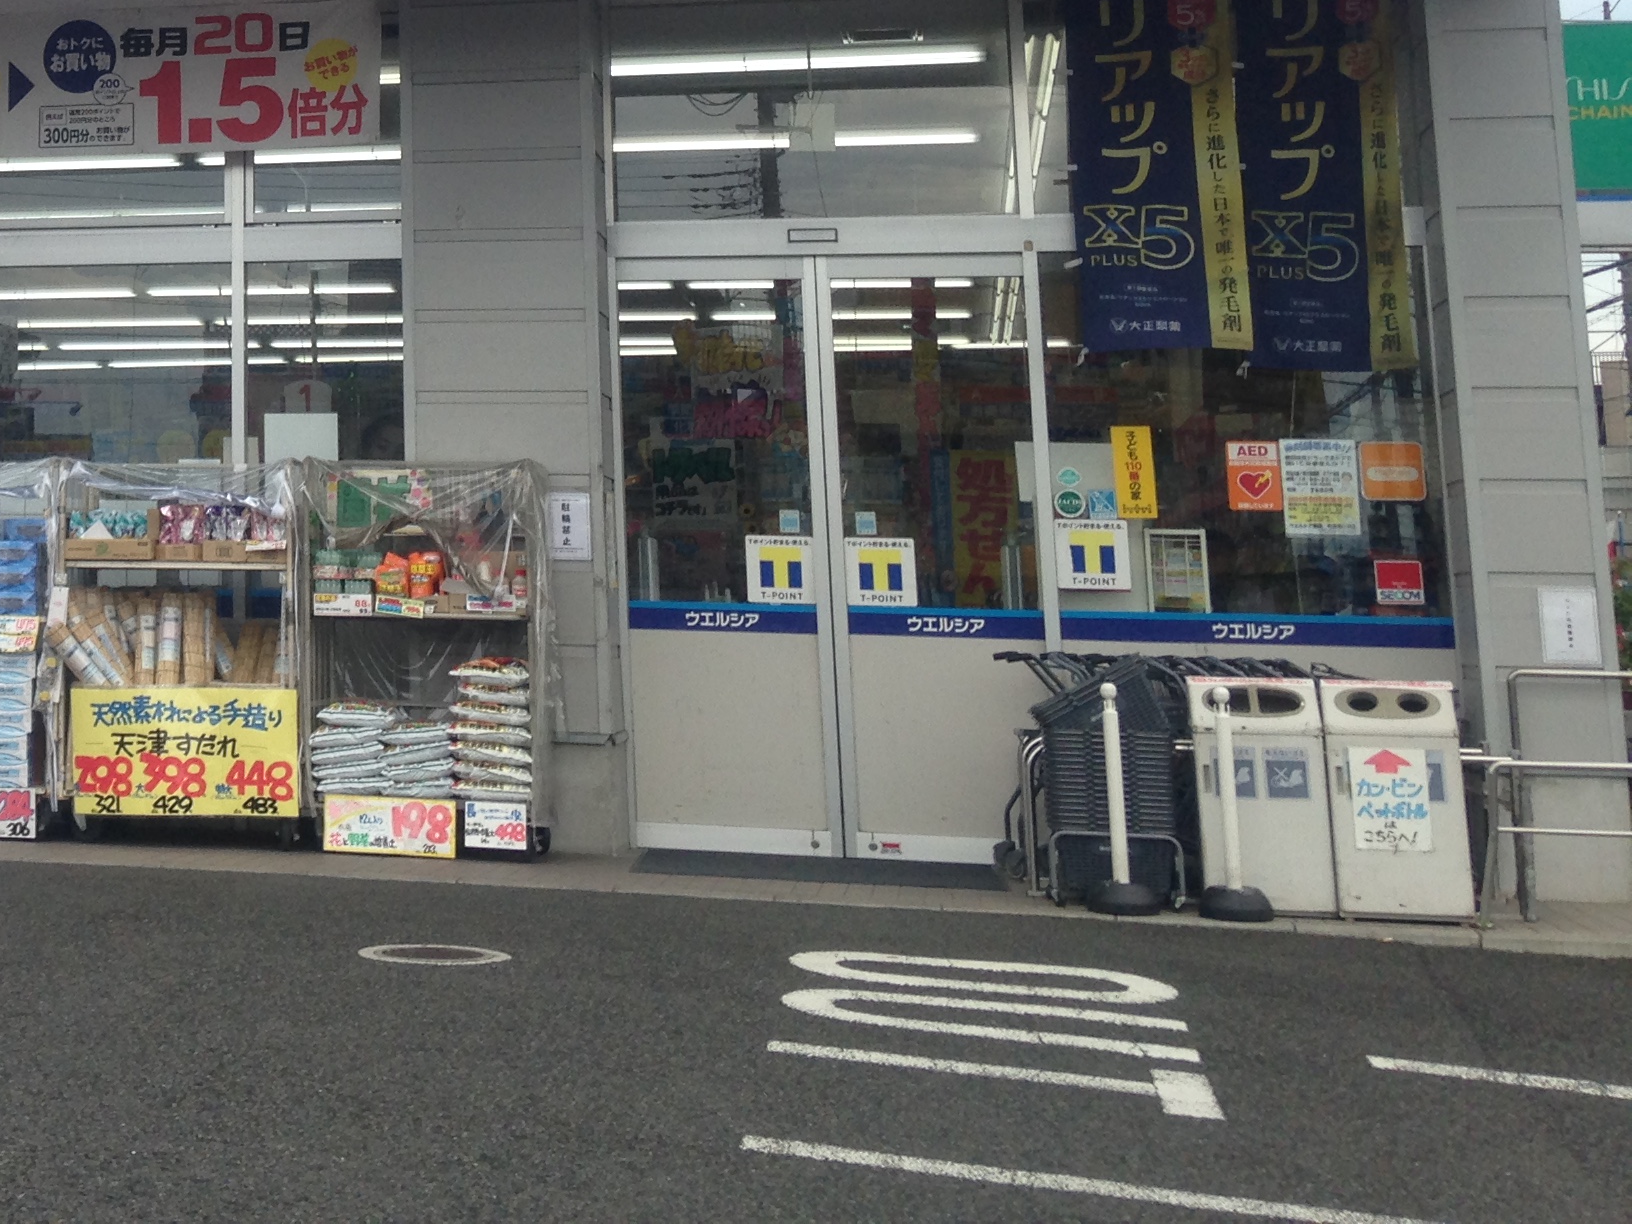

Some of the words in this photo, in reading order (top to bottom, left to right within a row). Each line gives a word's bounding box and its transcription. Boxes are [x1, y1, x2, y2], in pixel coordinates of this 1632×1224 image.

[56, 36, 104, 51] おトクに
[120, 12, 310, 58] 毎月20日
[49, 51, 111, 74] お買い物
[1090, 253, 1138, 267] PLUS
[1256, 265, 1305, 280] PLUS
[299, 384, 311, 412] 1
[1236, 445, 1269, 457] AED
[1072, 578, 1118, 587] T-POINT
[760, 591, 804, 601] T-POINT
[859, 594, 905, 604] T-POINT
[1380, 590, 1422, 601] SECOM
[684, 610, 760, 627] ウエルシア
[906, 616, 986, 634] ウエルシア
[1211, 623, 1296, 640] ウエルシア
[90, 694, 282, 732] 天然素材による手造り
[111, 728, 240, 758] 天津すだれ
[226, 759, 294, 802] 448
[94, 795, 121, 814] 321
[152, 796, 194, 814] 429
[241, 796, 278, 815] 483
[1356, 801, 1429, 820] ペットボトル
[5, 822, 30, 837] 306
[392, 801, 453, 844] 198
